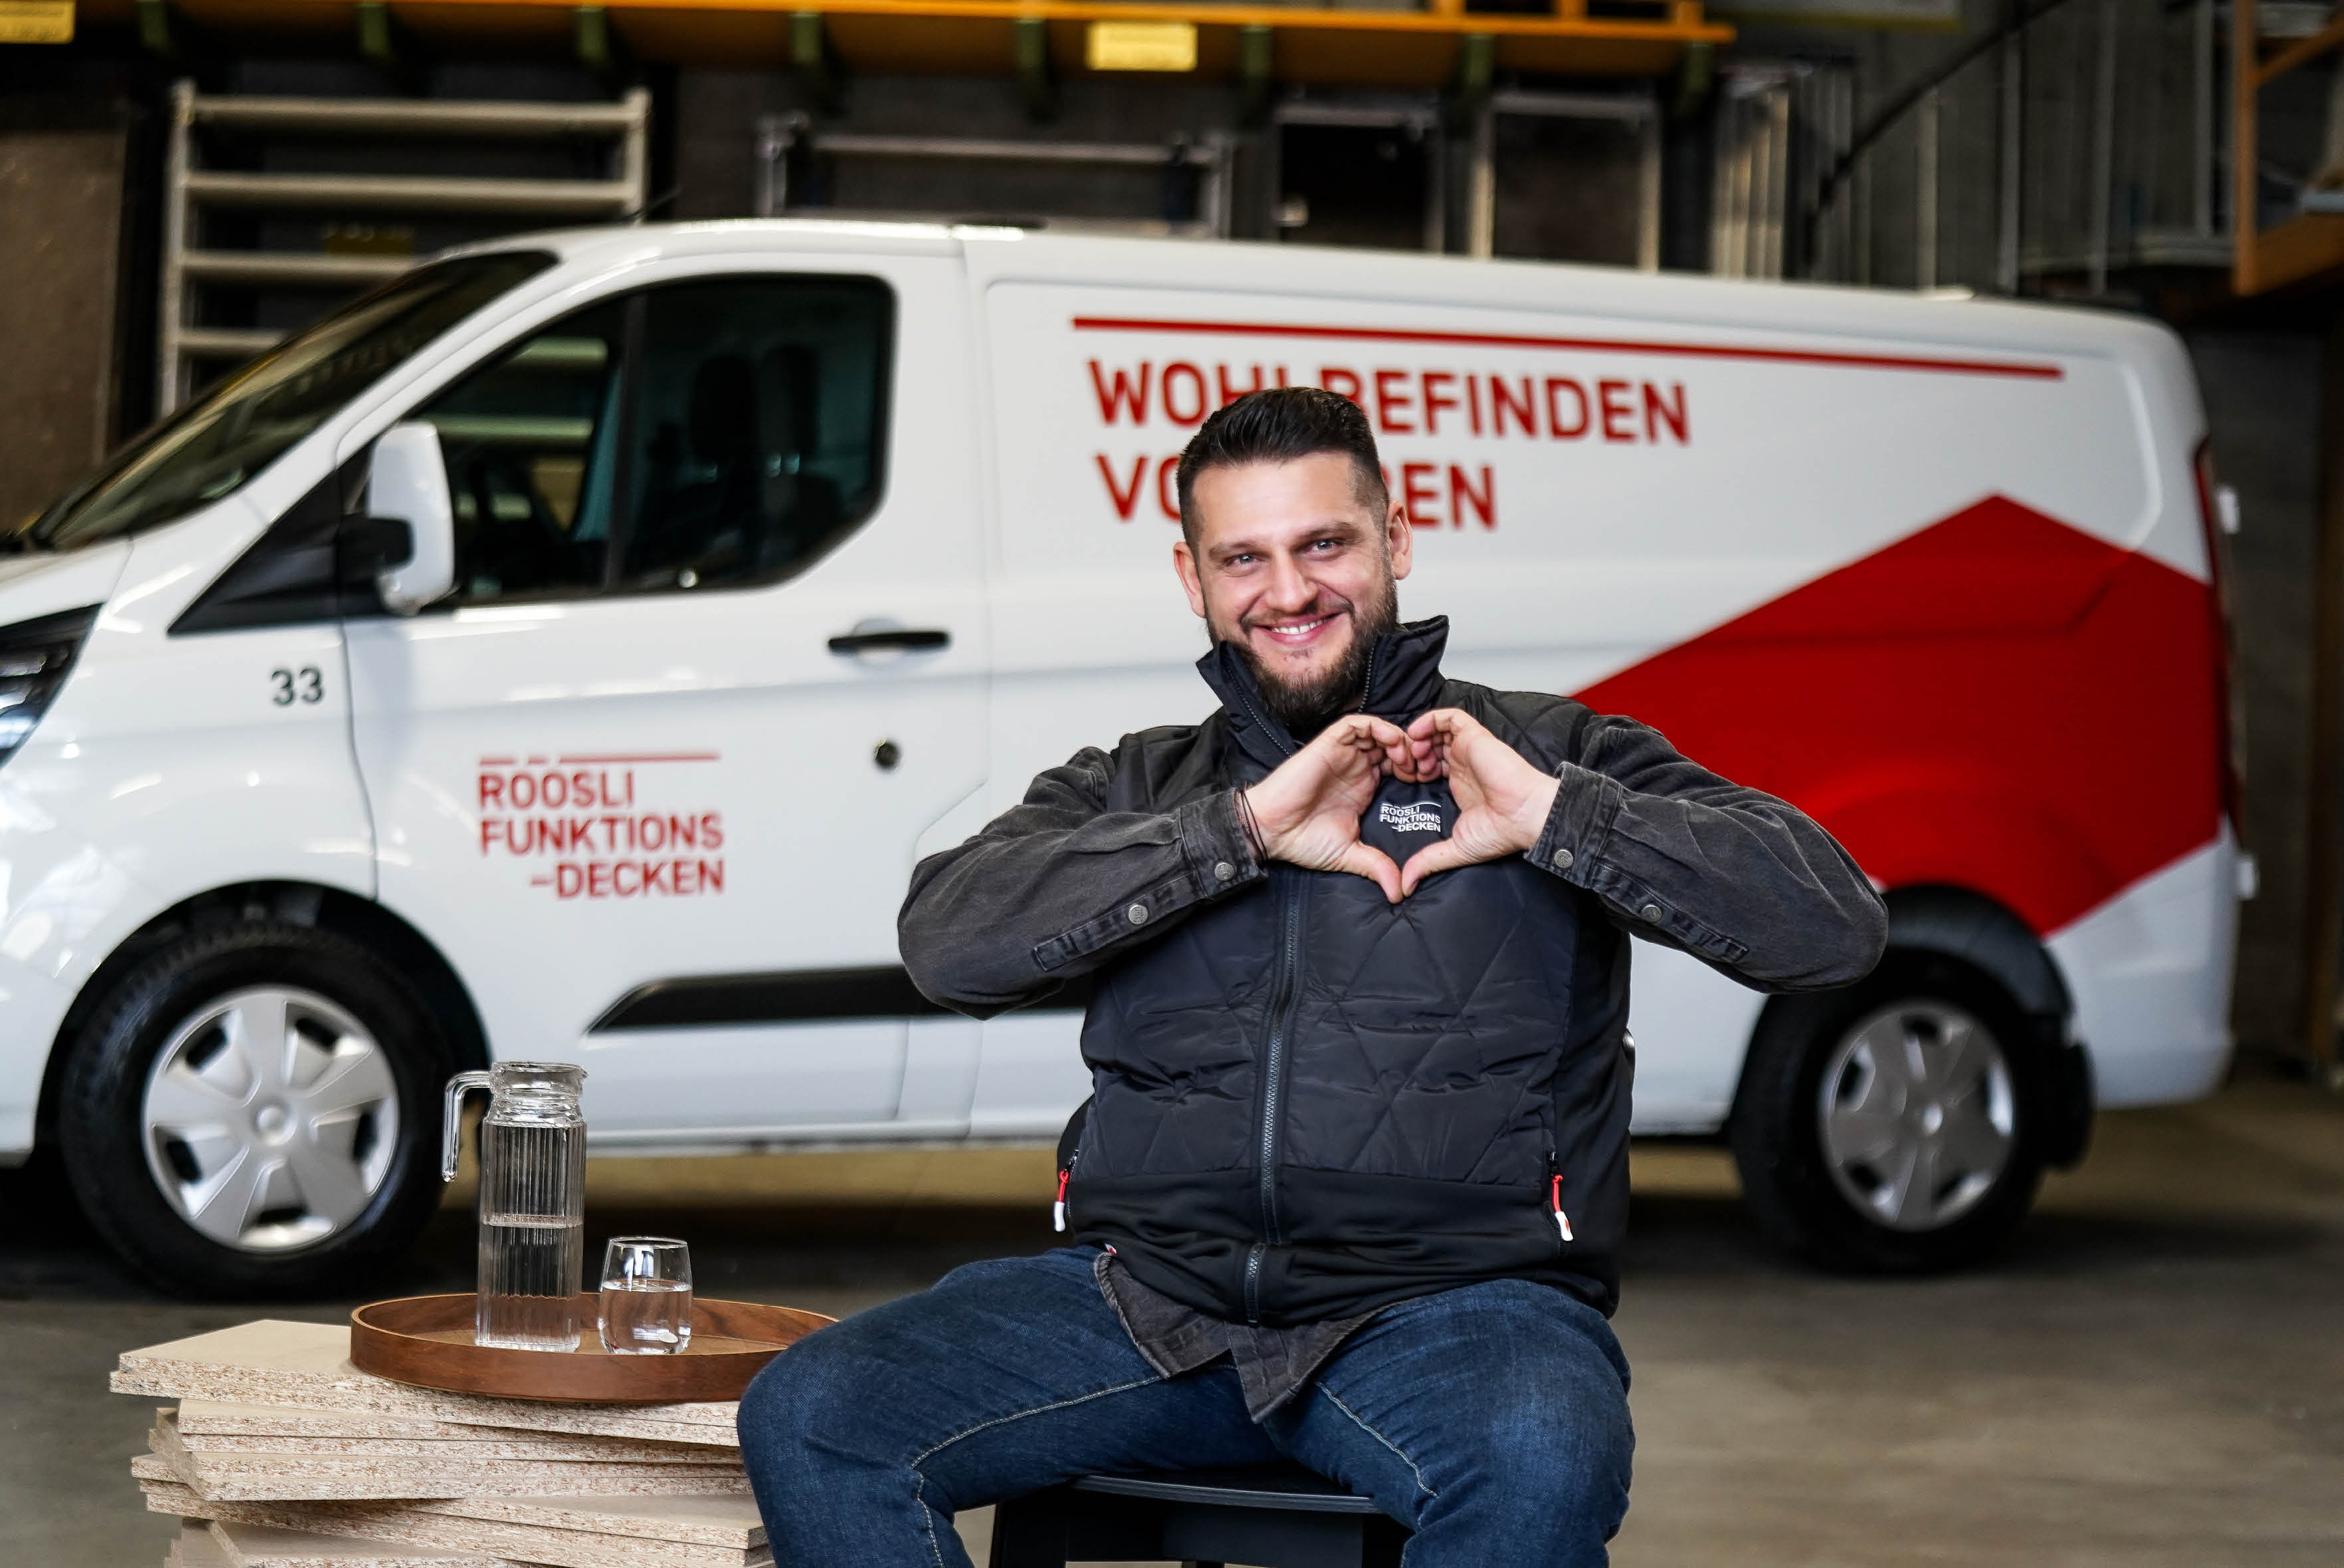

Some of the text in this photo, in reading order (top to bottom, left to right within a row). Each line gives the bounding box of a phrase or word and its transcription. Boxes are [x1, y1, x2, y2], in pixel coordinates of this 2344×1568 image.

[271, 666, 325, 706] 33
[480, 813, 723, 856] FUNKTIONS
[1379, 813, 1441, 825] FUNKTIONS
